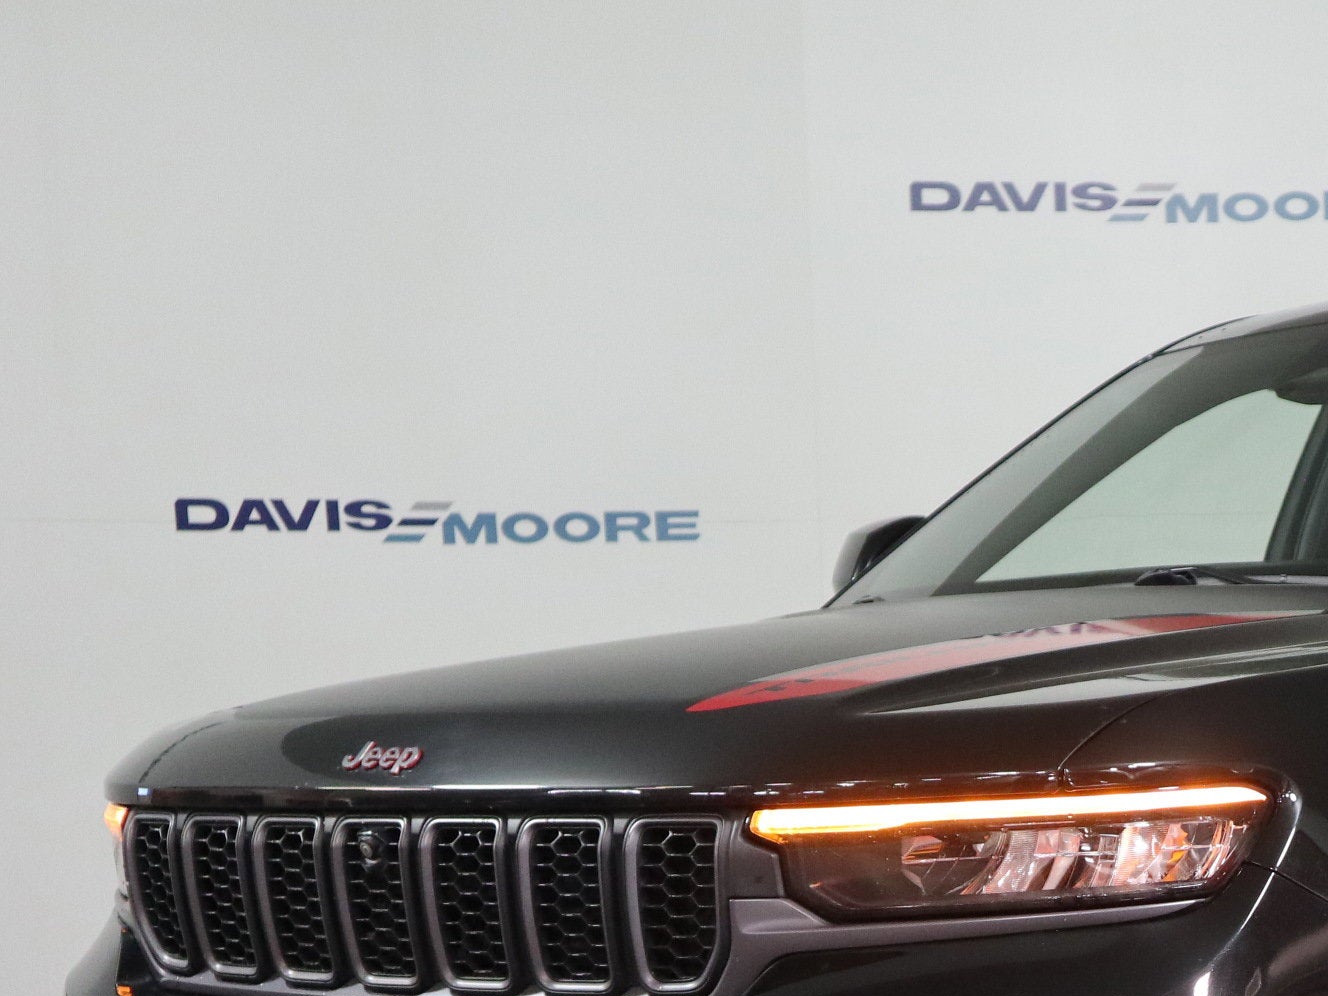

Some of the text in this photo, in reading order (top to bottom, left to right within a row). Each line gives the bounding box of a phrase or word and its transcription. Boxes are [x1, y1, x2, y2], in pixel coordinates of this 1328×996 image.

[908, 181, 1118, 213] DAVIS
[174, 497, 701, 546] DAVIS MOORE
[341, 740, 424, 776] Jeep
